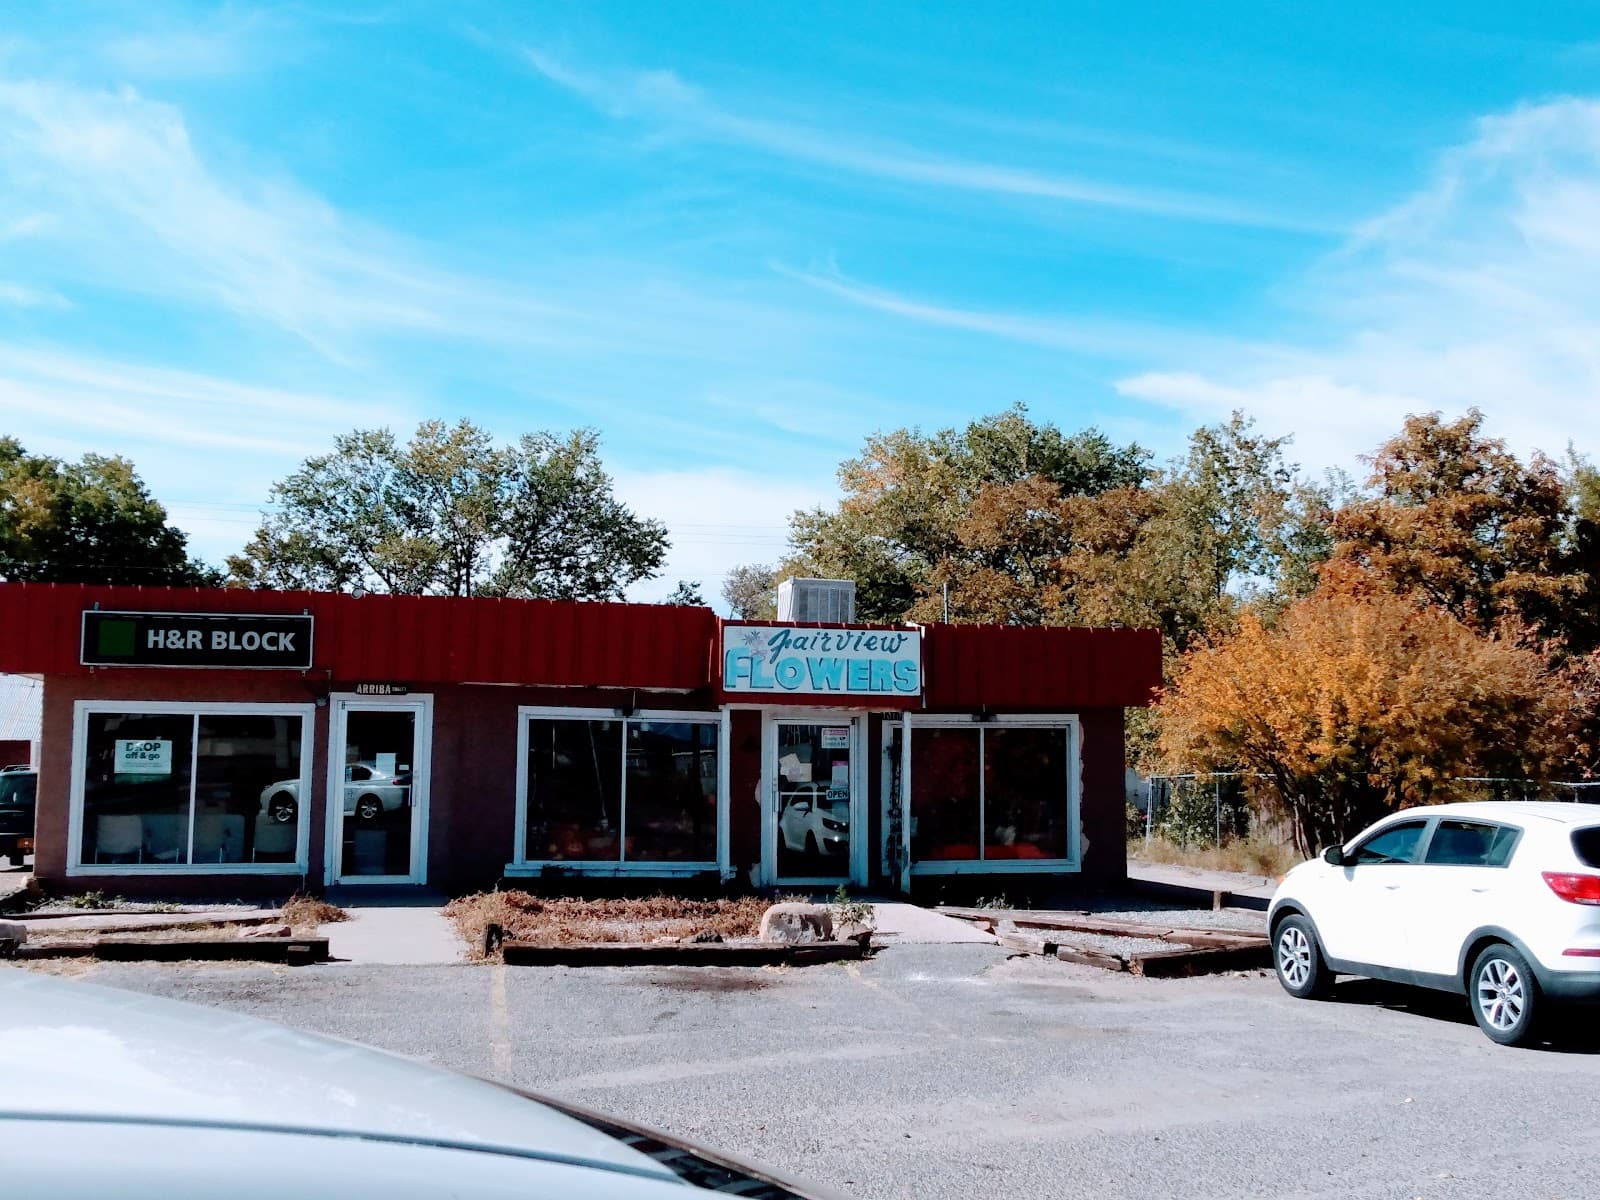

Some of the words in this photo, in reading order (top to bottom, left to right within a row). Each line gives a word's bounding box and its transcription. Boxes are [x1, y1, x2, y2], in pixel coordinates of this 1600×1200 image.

[147, 629, 203, 649] H&R
[211, 631, 296, 651] BLOCK
[767, 629, 908, 664] Fairview
[725, 647, 918, 692] FLOWERS
[357, 684, 390, 694] ARRIBA
[827, 790, 848, 799] OPEN
